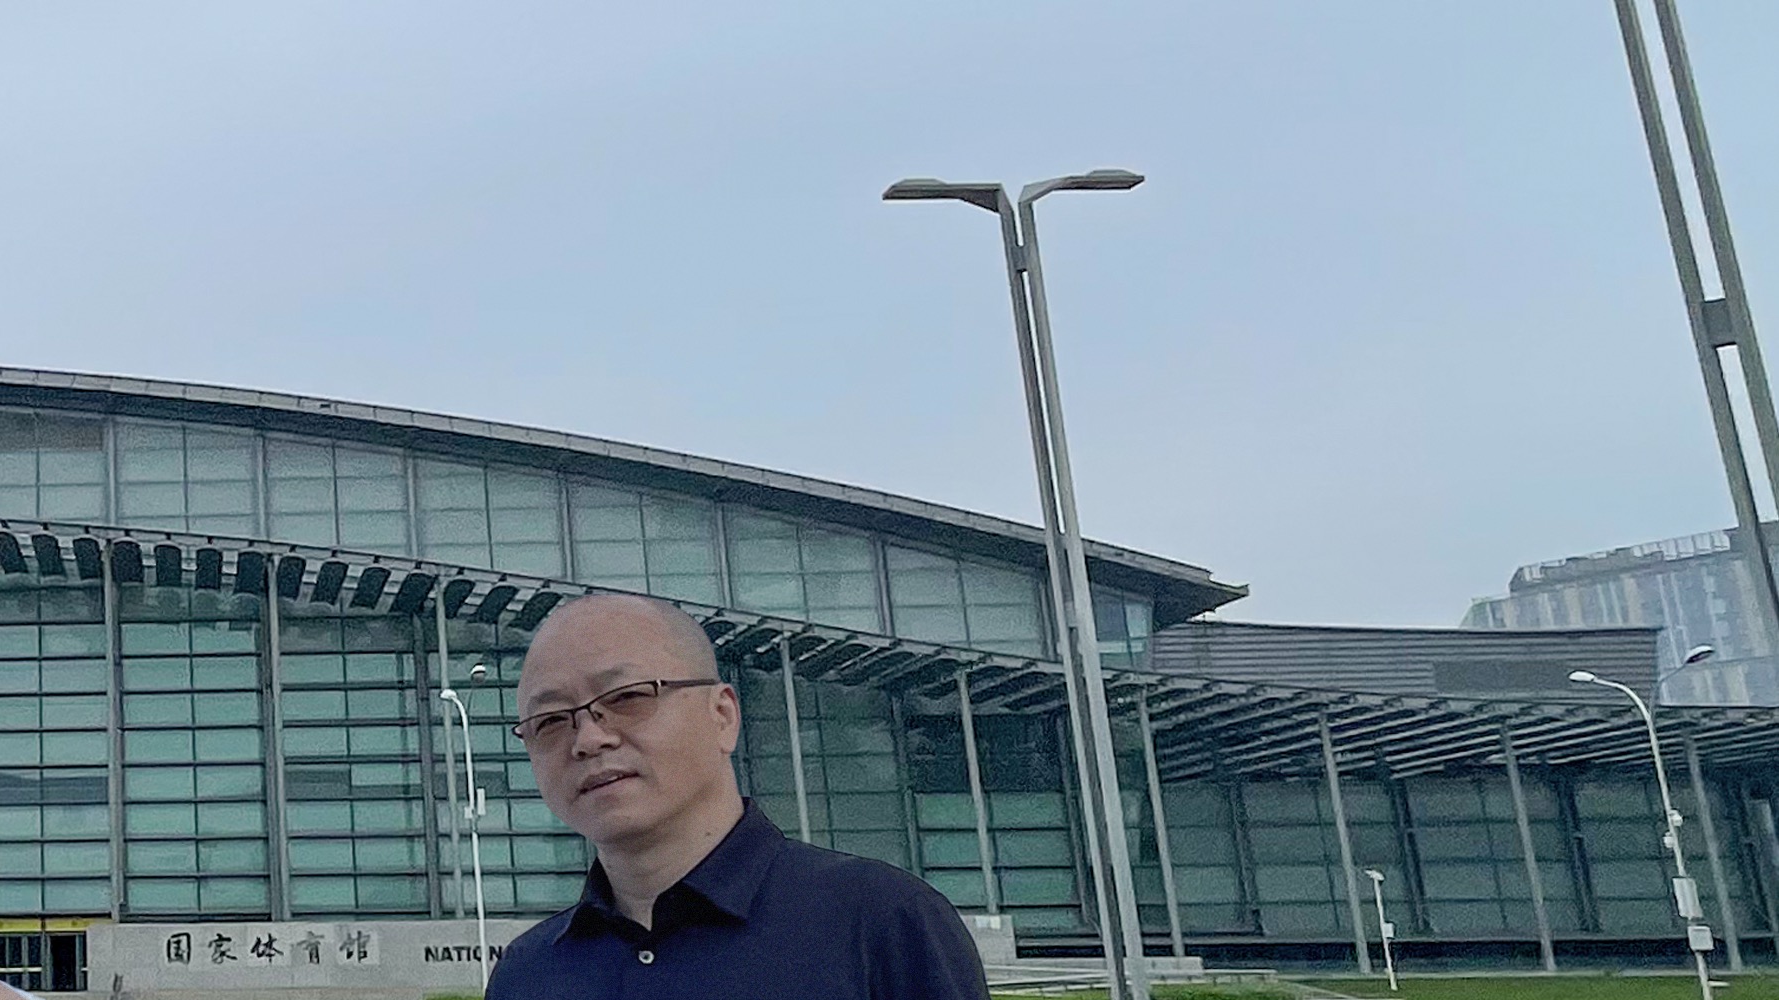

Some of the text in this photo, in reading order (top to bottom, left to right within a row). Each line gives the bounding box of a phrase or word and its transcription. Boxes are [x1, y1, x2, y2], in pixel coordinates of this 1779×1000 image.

[165, 930, 371, 965] 国家体育馆
[424, 945, 503, 962] NATION
